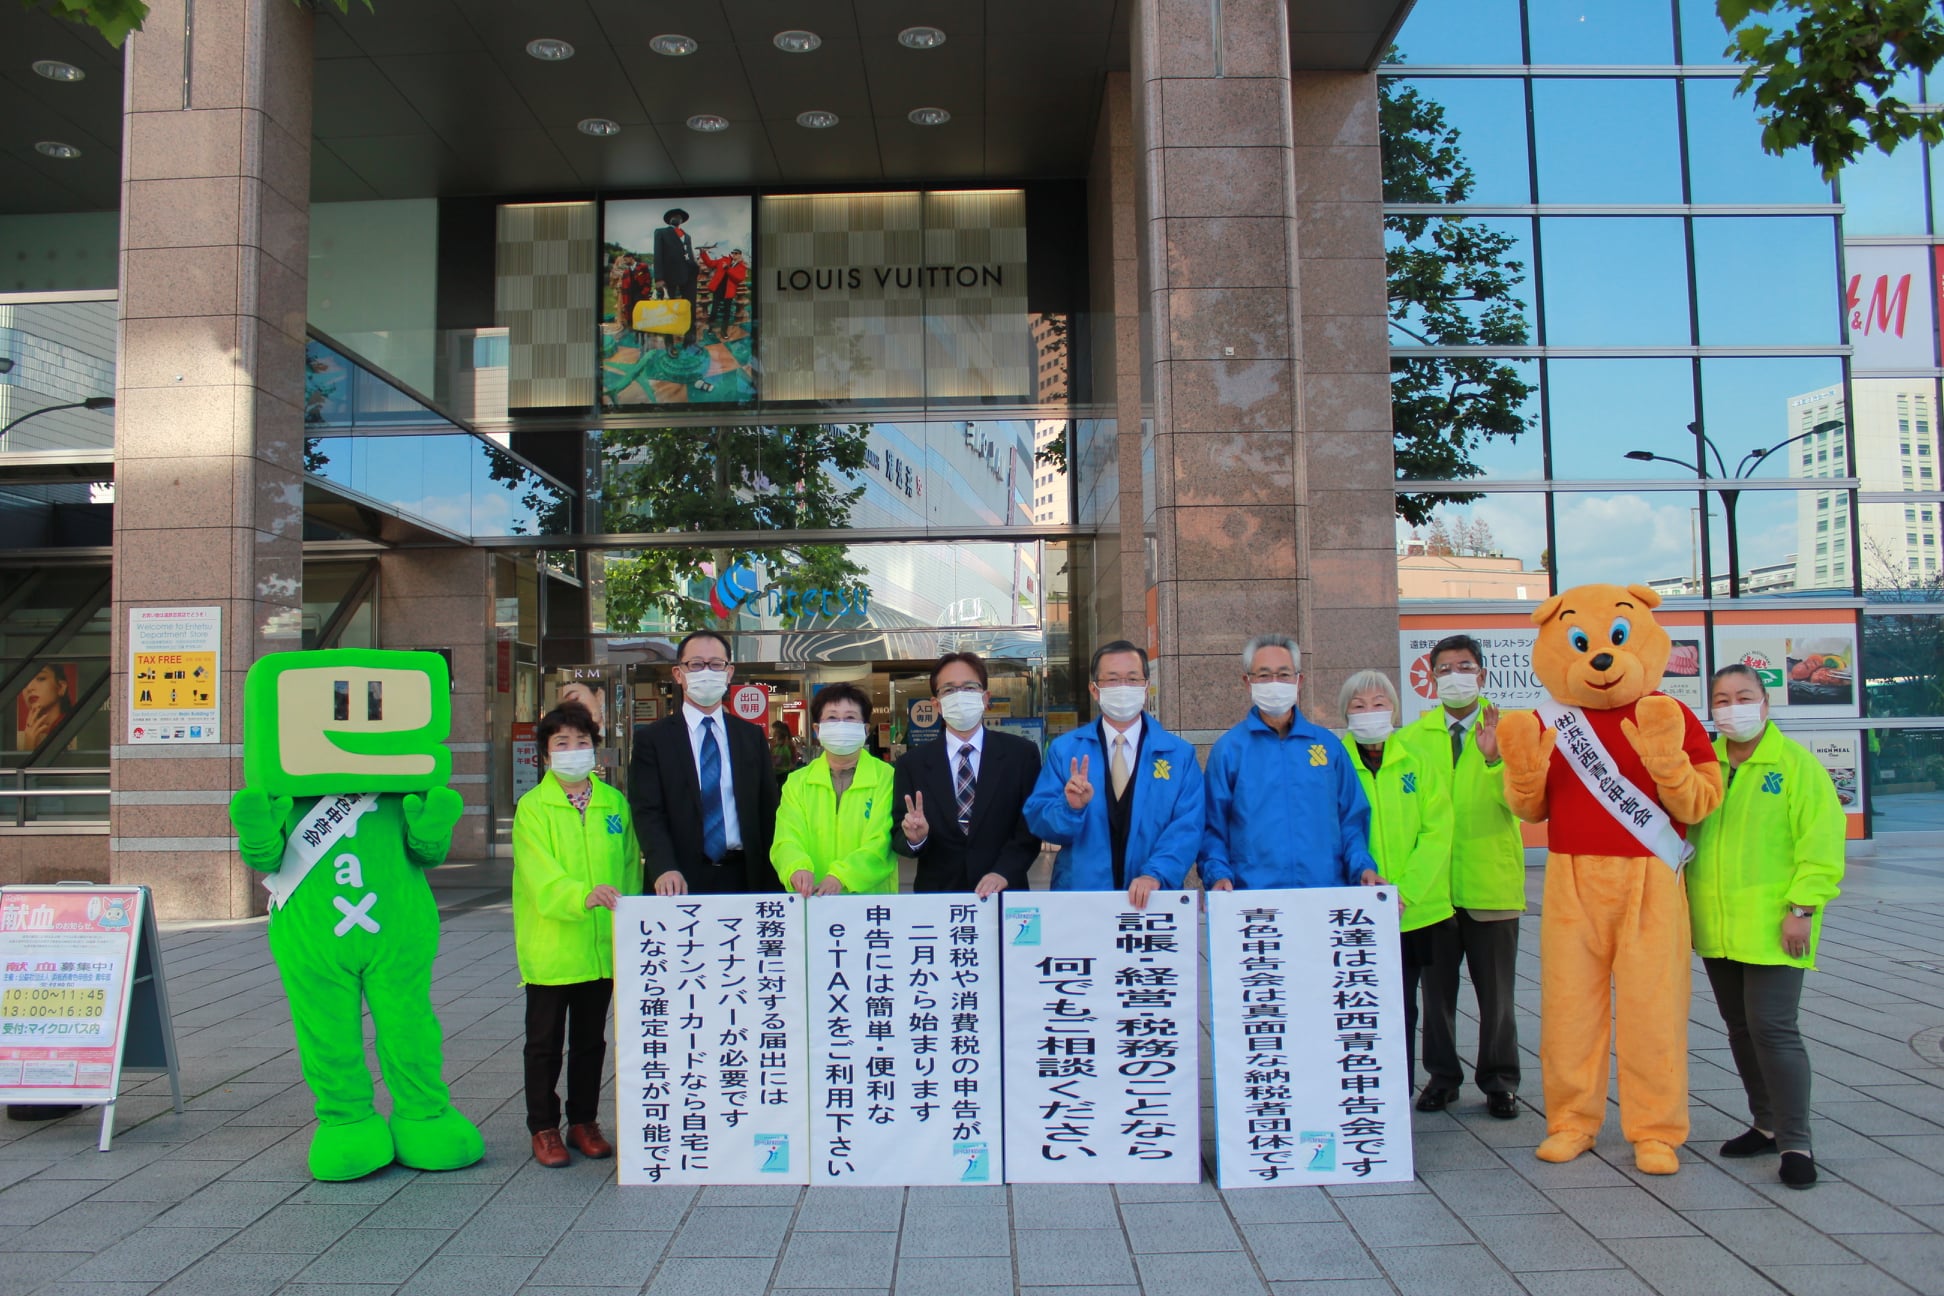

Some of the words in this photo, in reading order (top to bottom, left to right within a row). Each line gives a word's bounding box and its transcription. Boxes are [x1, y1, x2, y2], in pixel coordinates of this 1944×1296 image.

[777, 268, 861, 291] LOUIS
[874, 265, 1003, 288] VUITTON
[140, 631, 187, 639] Department
[745, 587, 868, 617] entetsu
[1410, 640, 1441, 649] 遠鉄百
[1494, 639, 1536, 648] レストラン
[138, 656, 155, 664] TAX
[158, 655, 182, 663] FREE
[740, 693, 760, 702] 出口
[740, 704, 760, 713] 専用
[916, 704, 932, 713] 入口
[1500, 691, 1541, 699] ダイニング
[916, 714, 932, 723] 専用
[0, 903, 55, 930] 献血
[2, 1023, 101, 1035] 受付:マイクロバス内
[640, 919, 671, 1182] いながら確定申告が可能です
[676, 903, 709, 1170] マイナンバーカードなら自宅に
[717, 917, 749, 1127] マイナンバーが必要です
[755, 901, 788, 1105] 税務署に対する届出には
[825, 923, 855, 1177] e-TAXをご利用下さい
[864, 904, 895, 1124] 申告には簡単・便利な
[908, 924, 940, 1122] 二月から始まります
[949, 904, 981, 1141] 所得税や消費税の申告が
[1035, 956, 1098, 1160] 何でもご相談ください
[1115, 912, 1179, 1160] 記帳・経営・税務のことなら
[1236, 907, 1295, 1181] 青色申告会は真面目な納税者団体です
[1328, 908, 1388, 1177] 私達は浜松西青色申告会です
